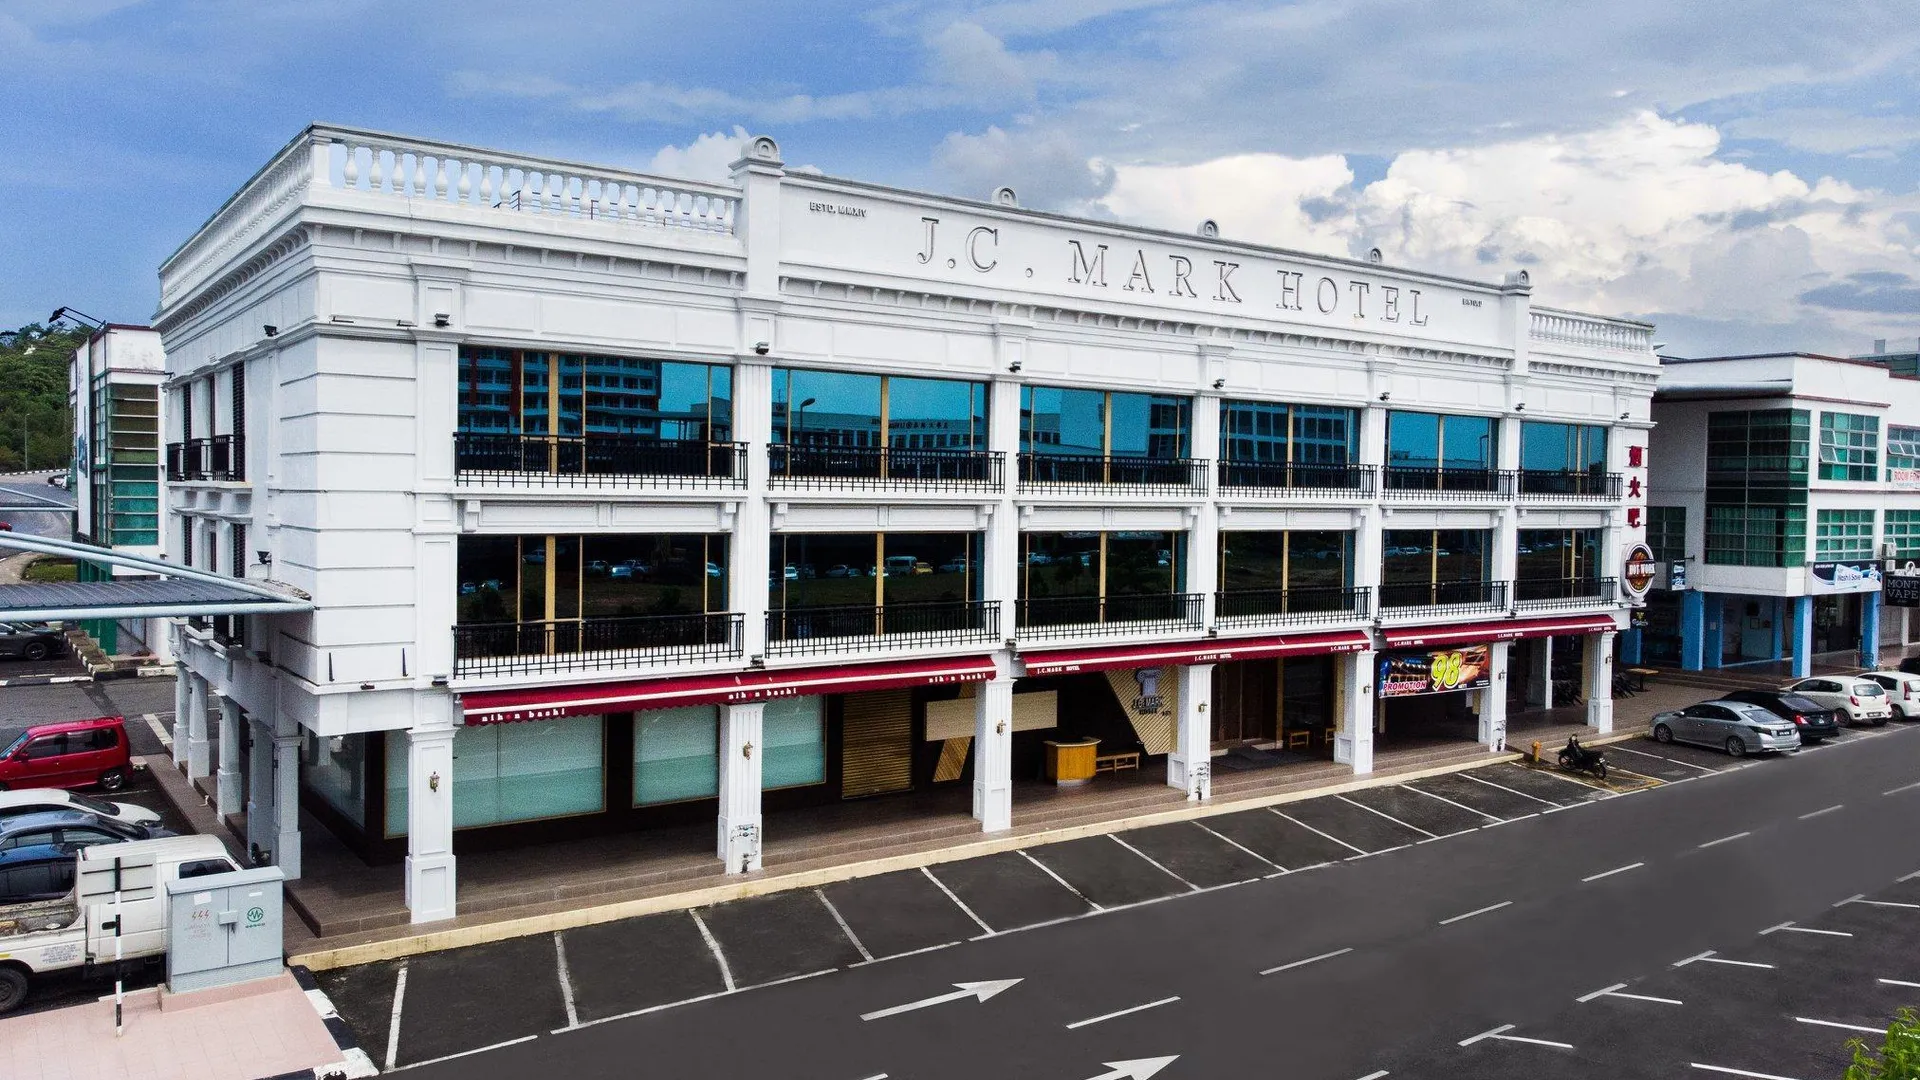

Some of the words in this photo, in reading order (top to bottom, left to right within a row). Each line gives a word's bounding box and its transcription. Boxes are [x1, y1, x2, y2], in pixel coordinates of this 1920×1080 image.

[809, 200, 836, 214] ESTD.
[838, 205, 867, 218] MMXIV
[1067, 239, 1242, 304] MARK
[1275, 268, 1429, 327] HOTEL
[1887, 580, 1919, 591] MONT
[1887, 588, 1919, 600] VAPE
[1431, 651, 1463, 692] 98
[1383, 679, 1427, 692] PROMOTION
[766, 687, 797, 697] bashi
[528, 707, 565, 719] bashi
